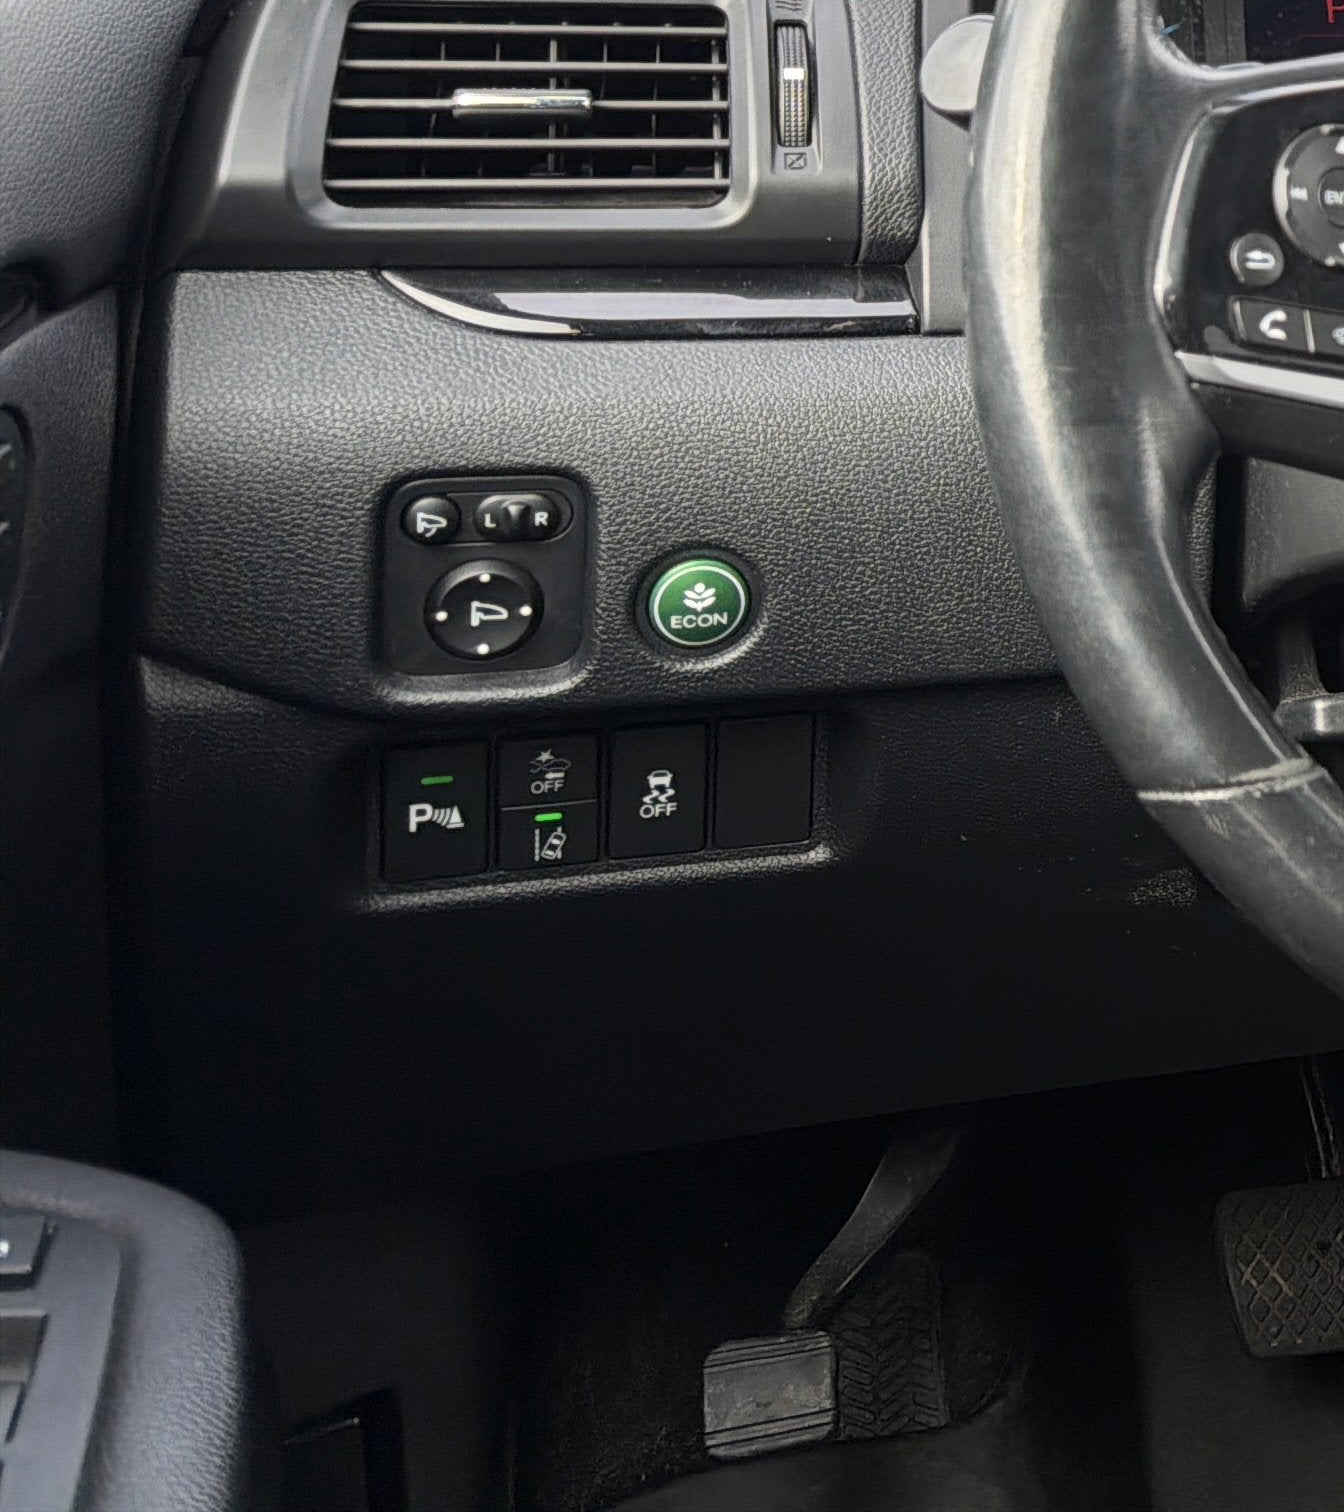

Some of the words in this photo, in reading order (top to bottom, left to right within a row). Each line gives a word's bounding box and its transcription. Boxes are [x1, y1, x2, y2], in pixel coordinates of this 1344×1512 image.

[485, 513, 496, 529] L
[534, 511, 548, 527] R
[669, 611, 729, 629] ECON
[530, 778, 566, 795] OFF
[639, 802, 678, 819] OFF
